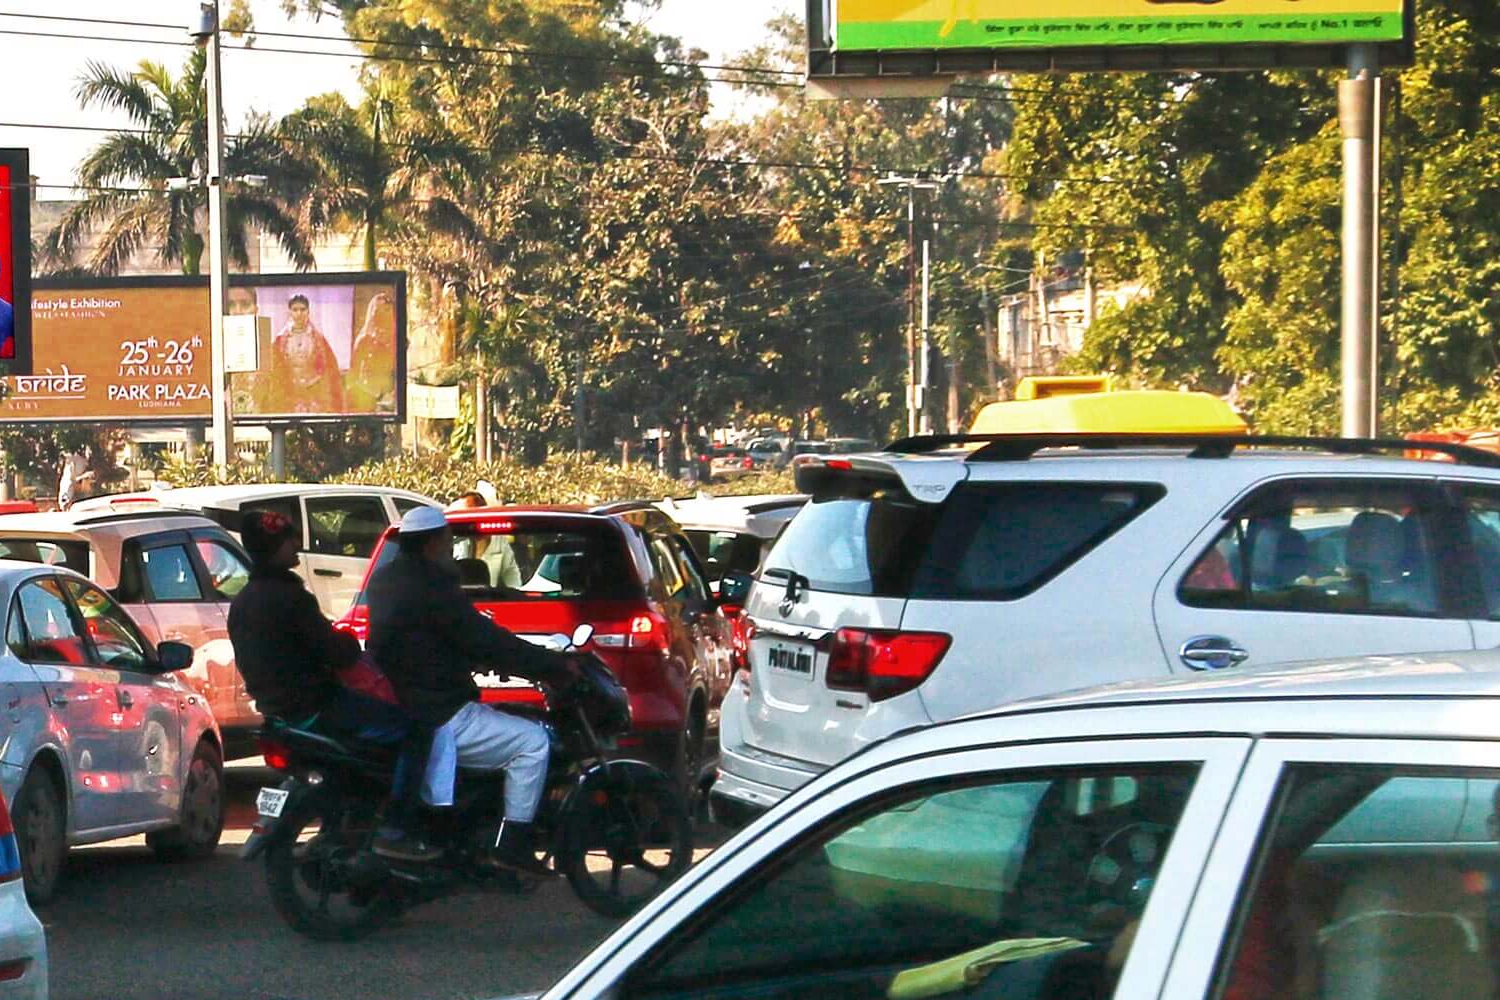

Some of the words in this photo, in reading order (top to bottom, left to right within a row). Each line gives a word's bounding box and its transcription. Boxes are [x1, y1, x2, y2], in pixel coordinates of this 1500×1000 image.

[31, 298, 68, 311] ifestyle
[70, 297, 121, 309] Exhibition
[118, 365, 194, 376] JANUARY
[15, 364, 86, 393] bride
[108, 384, 151, 400] PARK
[155, 384, 211, 400] PLAZA
